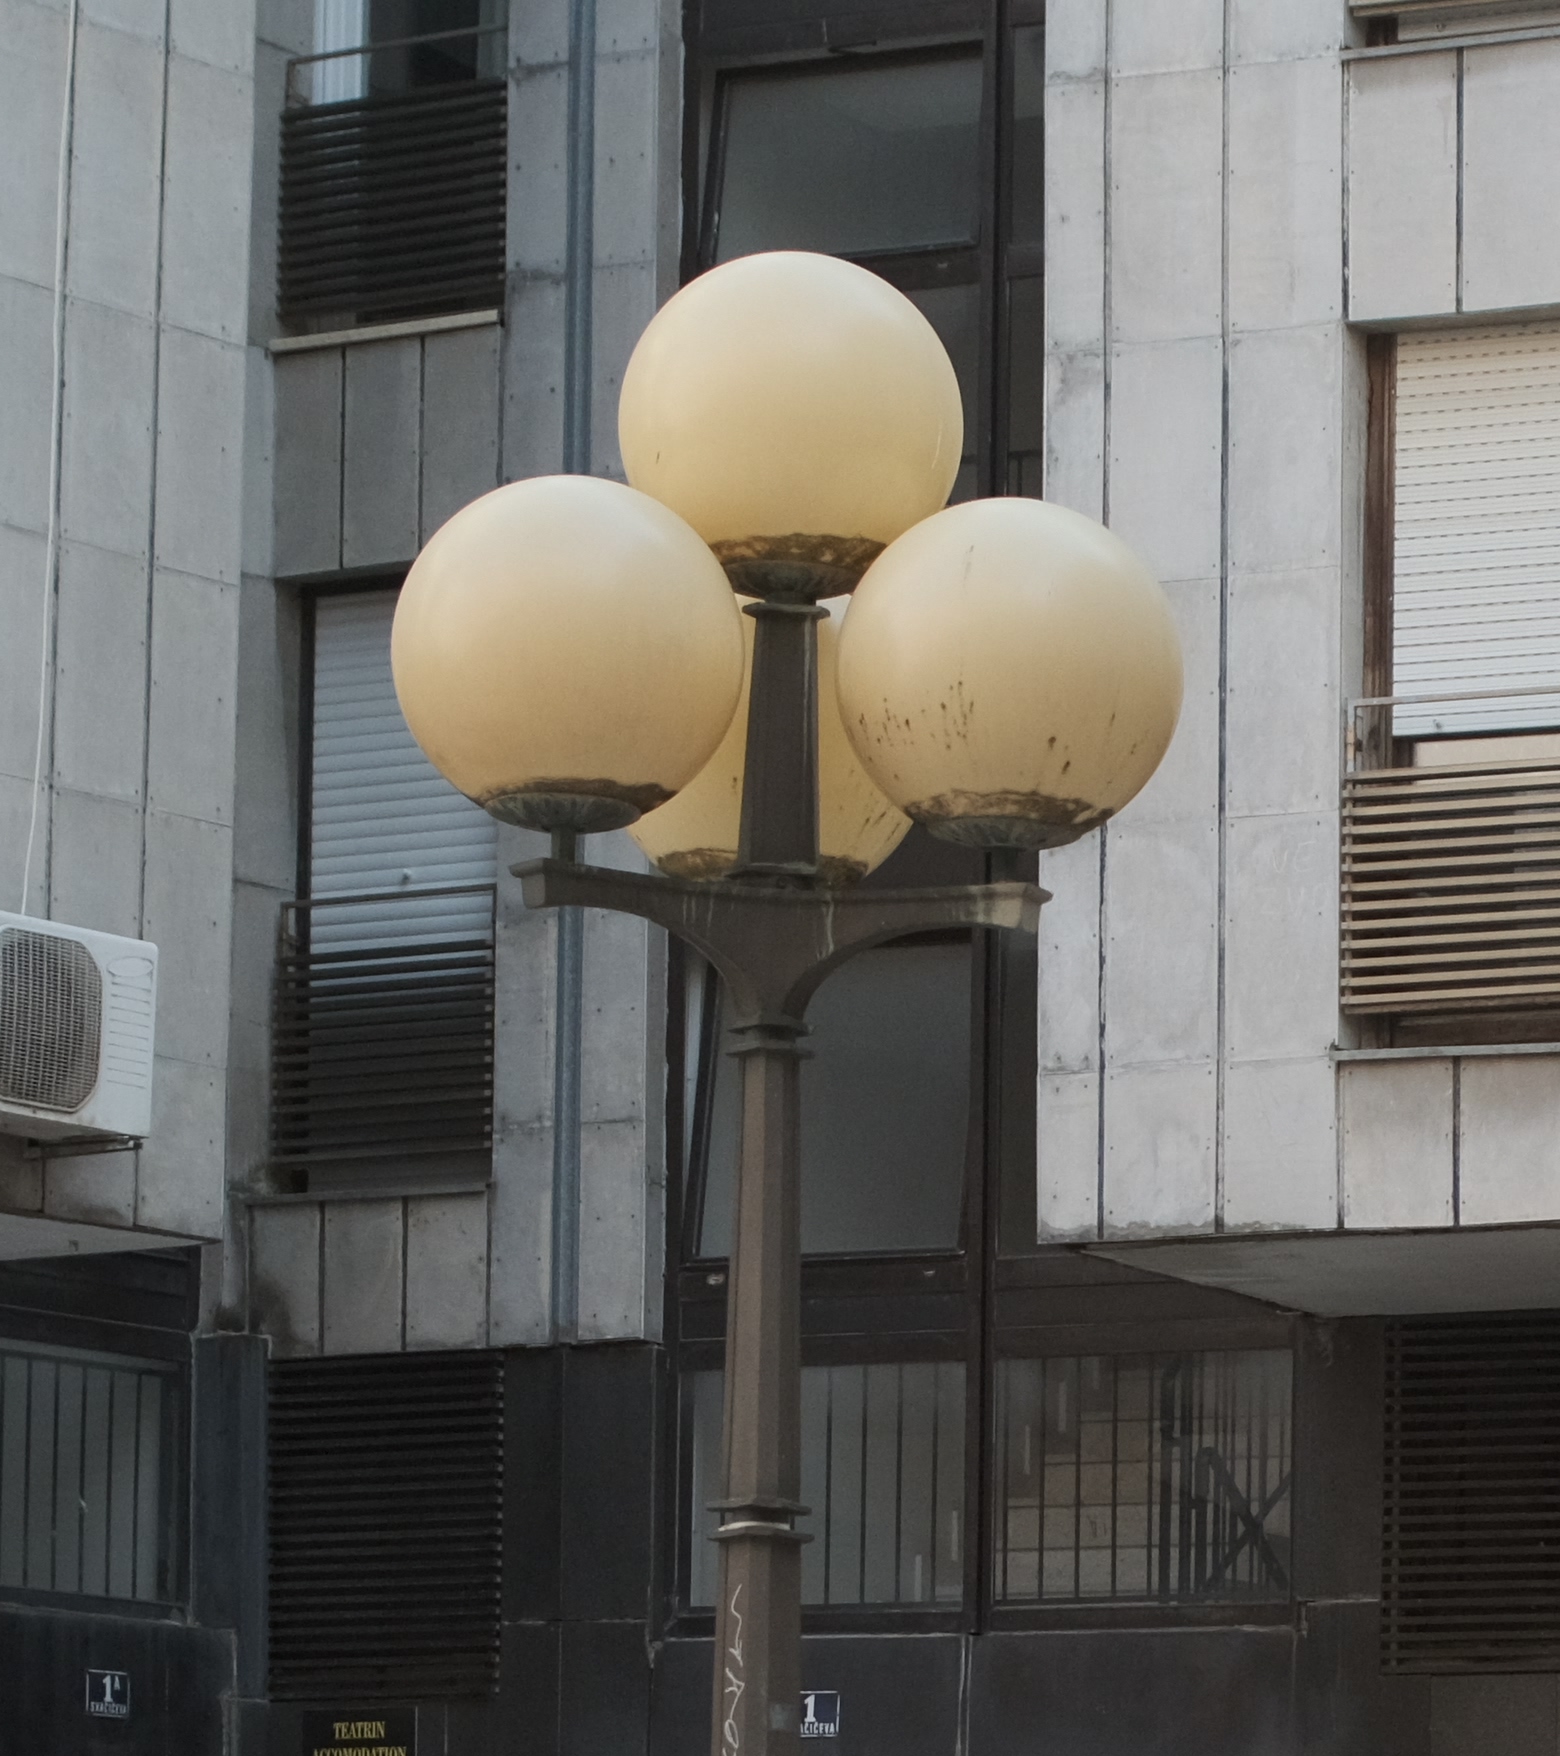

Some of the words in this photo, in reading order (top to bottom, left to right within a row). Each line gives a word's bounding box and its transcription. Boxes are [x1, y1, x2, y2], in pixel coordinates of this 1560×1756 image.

[102, 1674, 121, 1702] 1A
[803, 1693, 817, 1722] 1
[333, 1720, 386, 1740] TEATRIN
